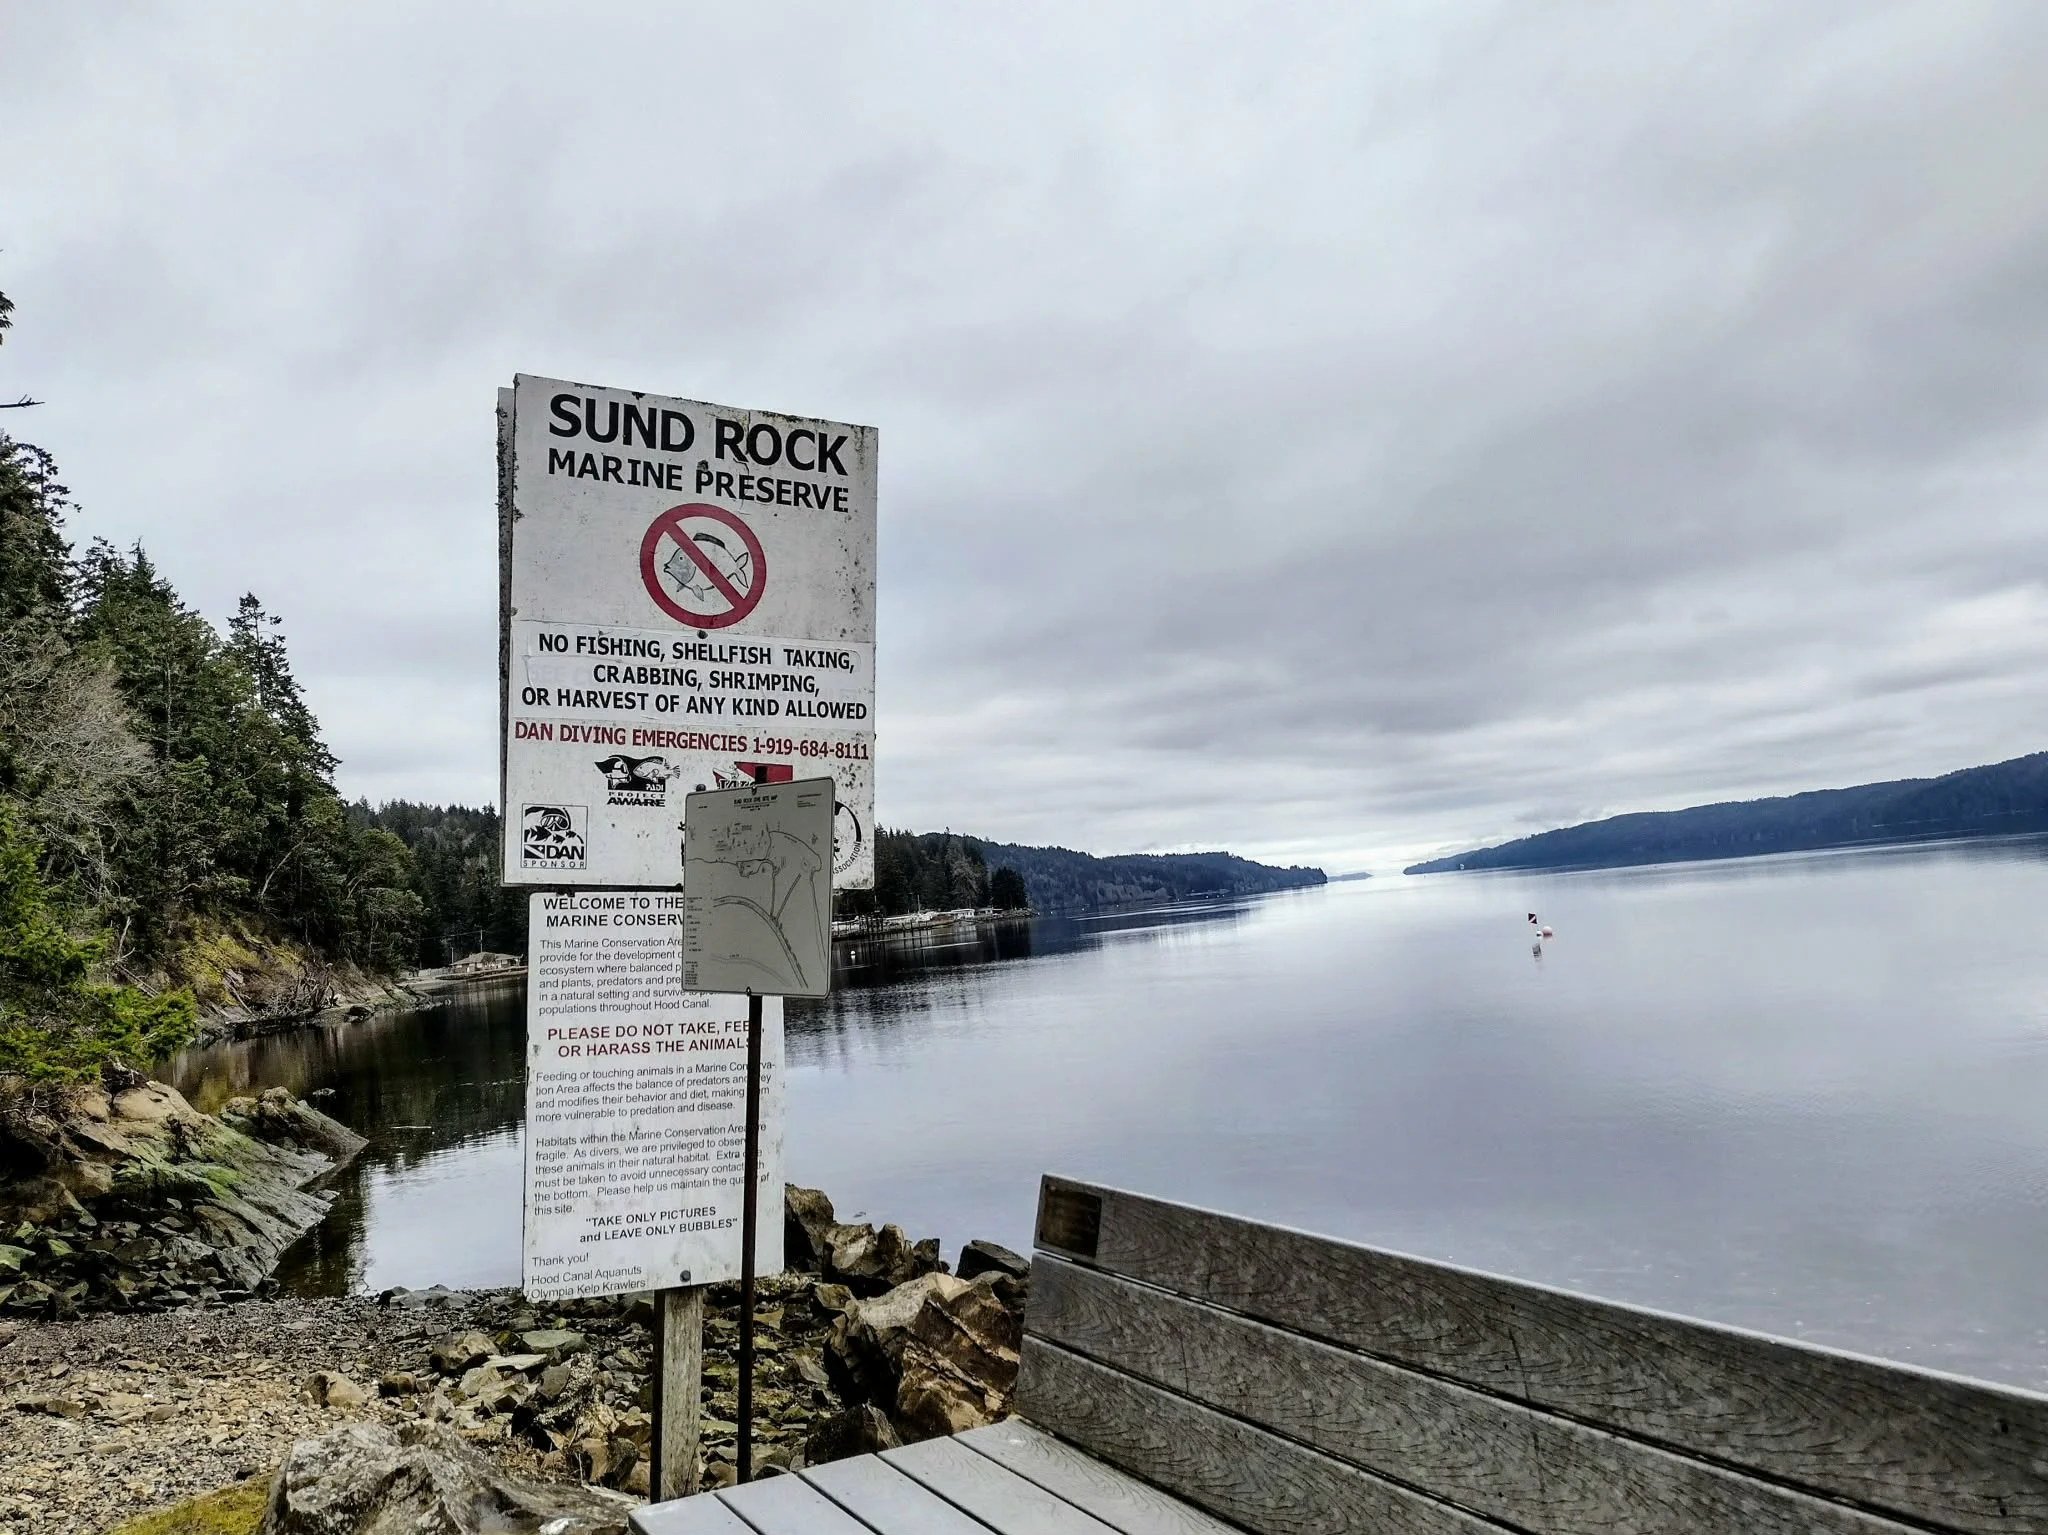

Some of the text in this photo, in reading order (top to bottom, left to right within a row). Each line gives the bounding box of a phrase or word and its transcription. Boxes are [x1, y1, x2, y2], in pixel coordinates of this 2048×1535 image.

[549, 393, 848, 476] SUND ROCK
[548, 448, 848, 513] MARINE PRESERVE
[539, 633, 854, 673] NO FISHING, SHELLFISH TAKING,
[593, 665, 819, 697] CRABBING, SHRIMPING,
[522, 687, 867, 719] OR HARVEST OF ANY KIND ALLOWED
[515, 721, 869, 760] DAN DIVING EMERGENCIES 1-919-684-8111
[607, 797, 665, 807] AWARE
[546, 845, 584, 860] DAN
[523, 860, 585, 868] SPONSOR
[543, 897, 625, 910] WELCOME
[630, 897, 650, 909] TO
[655, 897, 683, 909] THE
[546, 914, 608, 928] MARINE
[540, 939, 561, 949] This
[564, 938, 599, 949] Marine
[601, 937, 665, 948] Conservation
[539, 952, 577, 964] provide
[580, 952, 593, 961] for
[596, 951, 611, 961] the
[613, 951, 675, 963] development
[539, 965, 594, 977] ecosystem
[596, 964, 627, 974] where
[629, 963, 673, 973] balanced
[539, 976, 681, 990] and plants, predators and pre
[539, 992, 548, 1001] in
[551, 993, 558, 1001] a
[560, 990, 595, 1000] natural
[597, 989, 630, 1001] setting
[632, 988, 650, 998] and
[539, 999, 712, 1016] populations throughout Hood Canal.
[548, 1020, 765, 1040] PLEASE DO NOT TAKE, FEE,
[558, 1045, 581, 1057] OR
[586, 1041, 651, 1056] HARASS
[656, 1040, 685, 1053] THE
[536, 1071, 577, 1083] Feeding
[580, 1072, 590, 1080] or
[592, 1068, 634, 1080] touching
[636, 1065, 673, 1076] animals
[676, 1065, 685, 1074] in
[695, 1063, 727, 1073] Marine
[536, 1086, 554, 1096] tion
[556, 1084, 580, 1095] Area
[582, 1082, 615, 1093] affects
[618, 1081, 633, 1090] the
[635, 1079, 673, 1089] balance
[675, 1078, 685, 1087] of
[686, 1076, 730, 1089] predators
[535, 1098, 555, 1109] and
[558, 1095, 599, 1107] modifies
[602, 1094, 624, 1104] their
[626, 1092, 667, 1103] behavior
[670, 1090, 688, 1100] and
[712, 1087, 745, 1098] making
[535, 1101, 735, 1122] more vulnerable to predation and disease.
[536, 1136, 577, 1148] Habitats
[580, 1134, 608, 1145] within
[611, 1132, 626, 1142] the
[629, 1130, 662, 1141] Marine
[664, 1125, 726, 1138] Conservation
[535, 1151, 568, 1162] fragile.
[573, 1149, 586, 1158] As
[624, 1146, 639, 1154] we
[641, 1145, 657, 1153] are
[660, 1139, 705, 1154] privileged
[707, 1139, 716, 1148] to
[535, 1164, 563, 1175] these
[566, 1161, 604, 1172] animals
[607, 1160, 616, 1169] in
[619, 1158, 640, 1168] their
[642, 1155, 675, 1166] natural
[677, 1152, 710, 1163] habitat.
[716, 1150, 740, 1160] Extra
[535, 1162, 745, 1188] must be taken to avoid unnecessary contact
[535, 1192, 551, 1202] the
[553, 1189, 591, 1201] bottom.
[597, 1185, 631, 1197] Please
[633, 1182, 654, 1194] help
[656, 1183, 668, 1191] us
[670, 1178, 710, 1190] maintain
[712, 1176, 727, 1186] the
[534, 1204, 575, 1216] this site.
[586, 1206, 716, 1227] "TAKE ONLY PICTURES
[579, 1218, 738, 1243] and LEAVE ONLY BUBBLES"
[532, 1252, 589, 1267] Thank you!
[531, 1266, 642, 1285] Hood Canal Aquanuts
[531, 1279, 646, 1299] Olympia Kelp Krawlers
